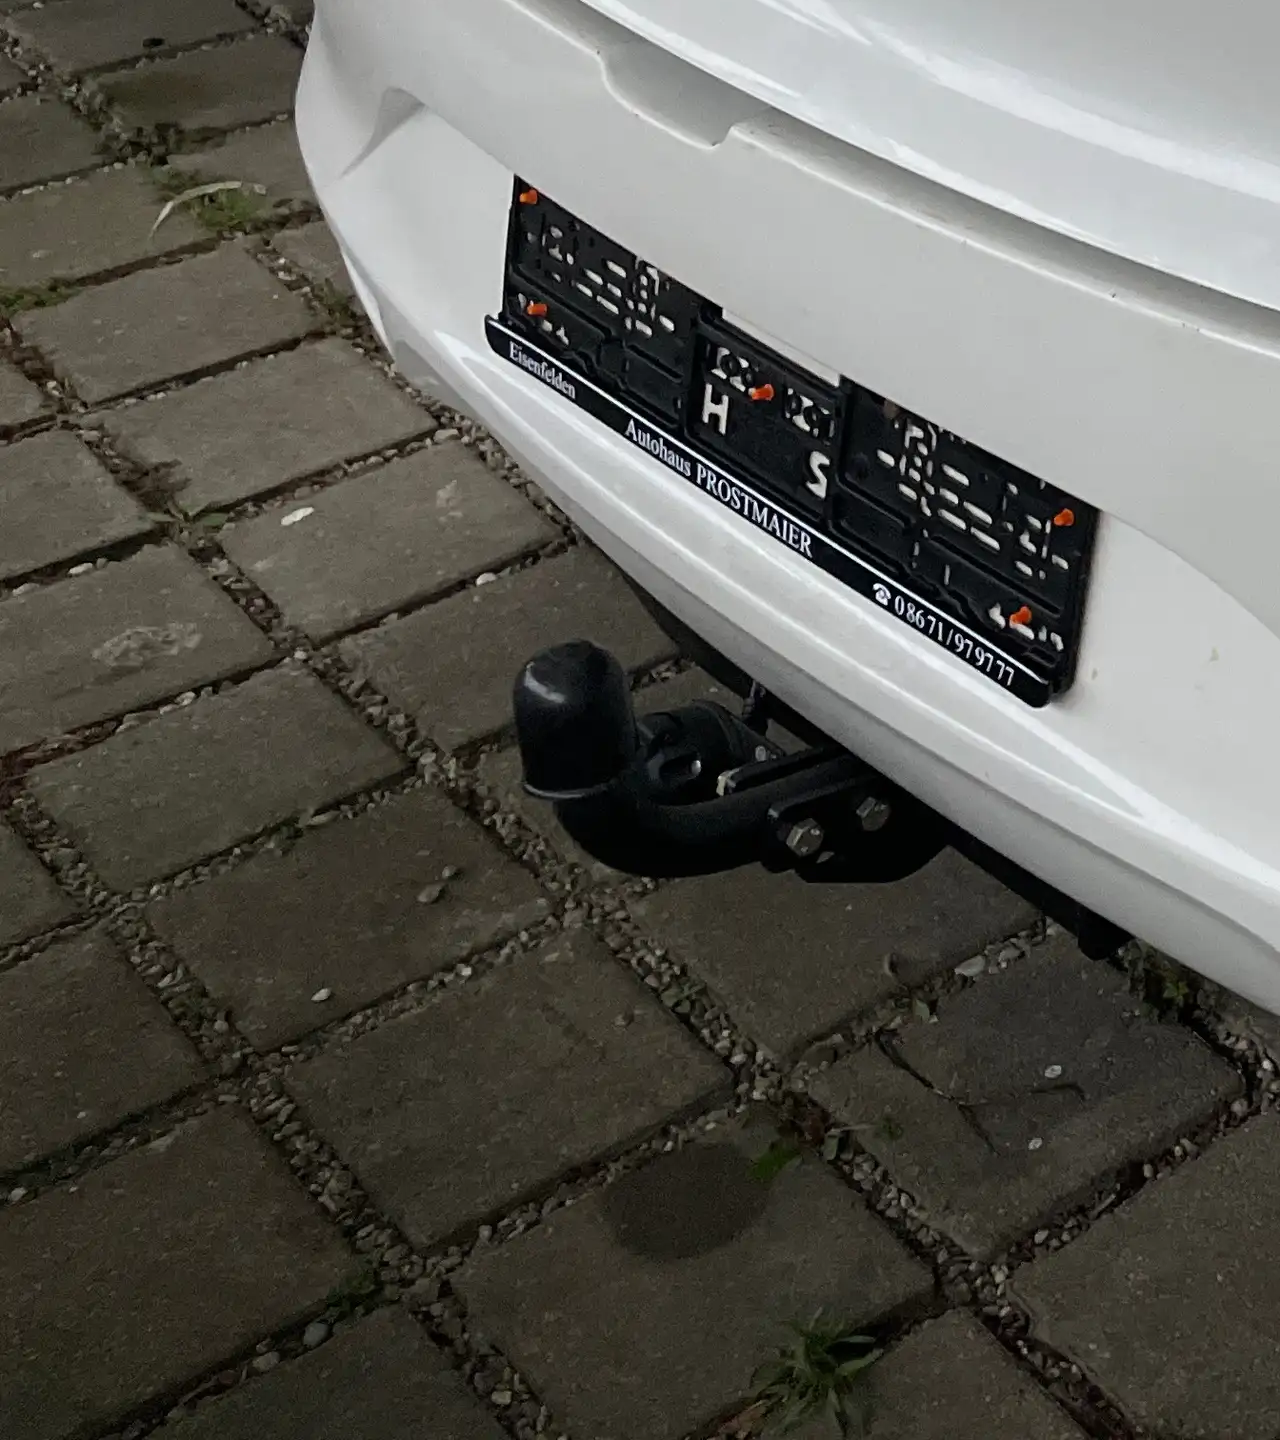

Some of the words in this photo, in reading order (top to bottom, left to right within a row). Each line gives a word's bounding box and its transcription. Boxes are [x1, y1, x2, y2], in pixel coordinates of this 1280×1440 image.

[509, 340, 576, 400] Eisenfelden
[624, 418, 692, 478] Autohaus
[696, 462, 813, 559] PROSTMAIER
[893, 595, 1015, 687] 08671/979777
